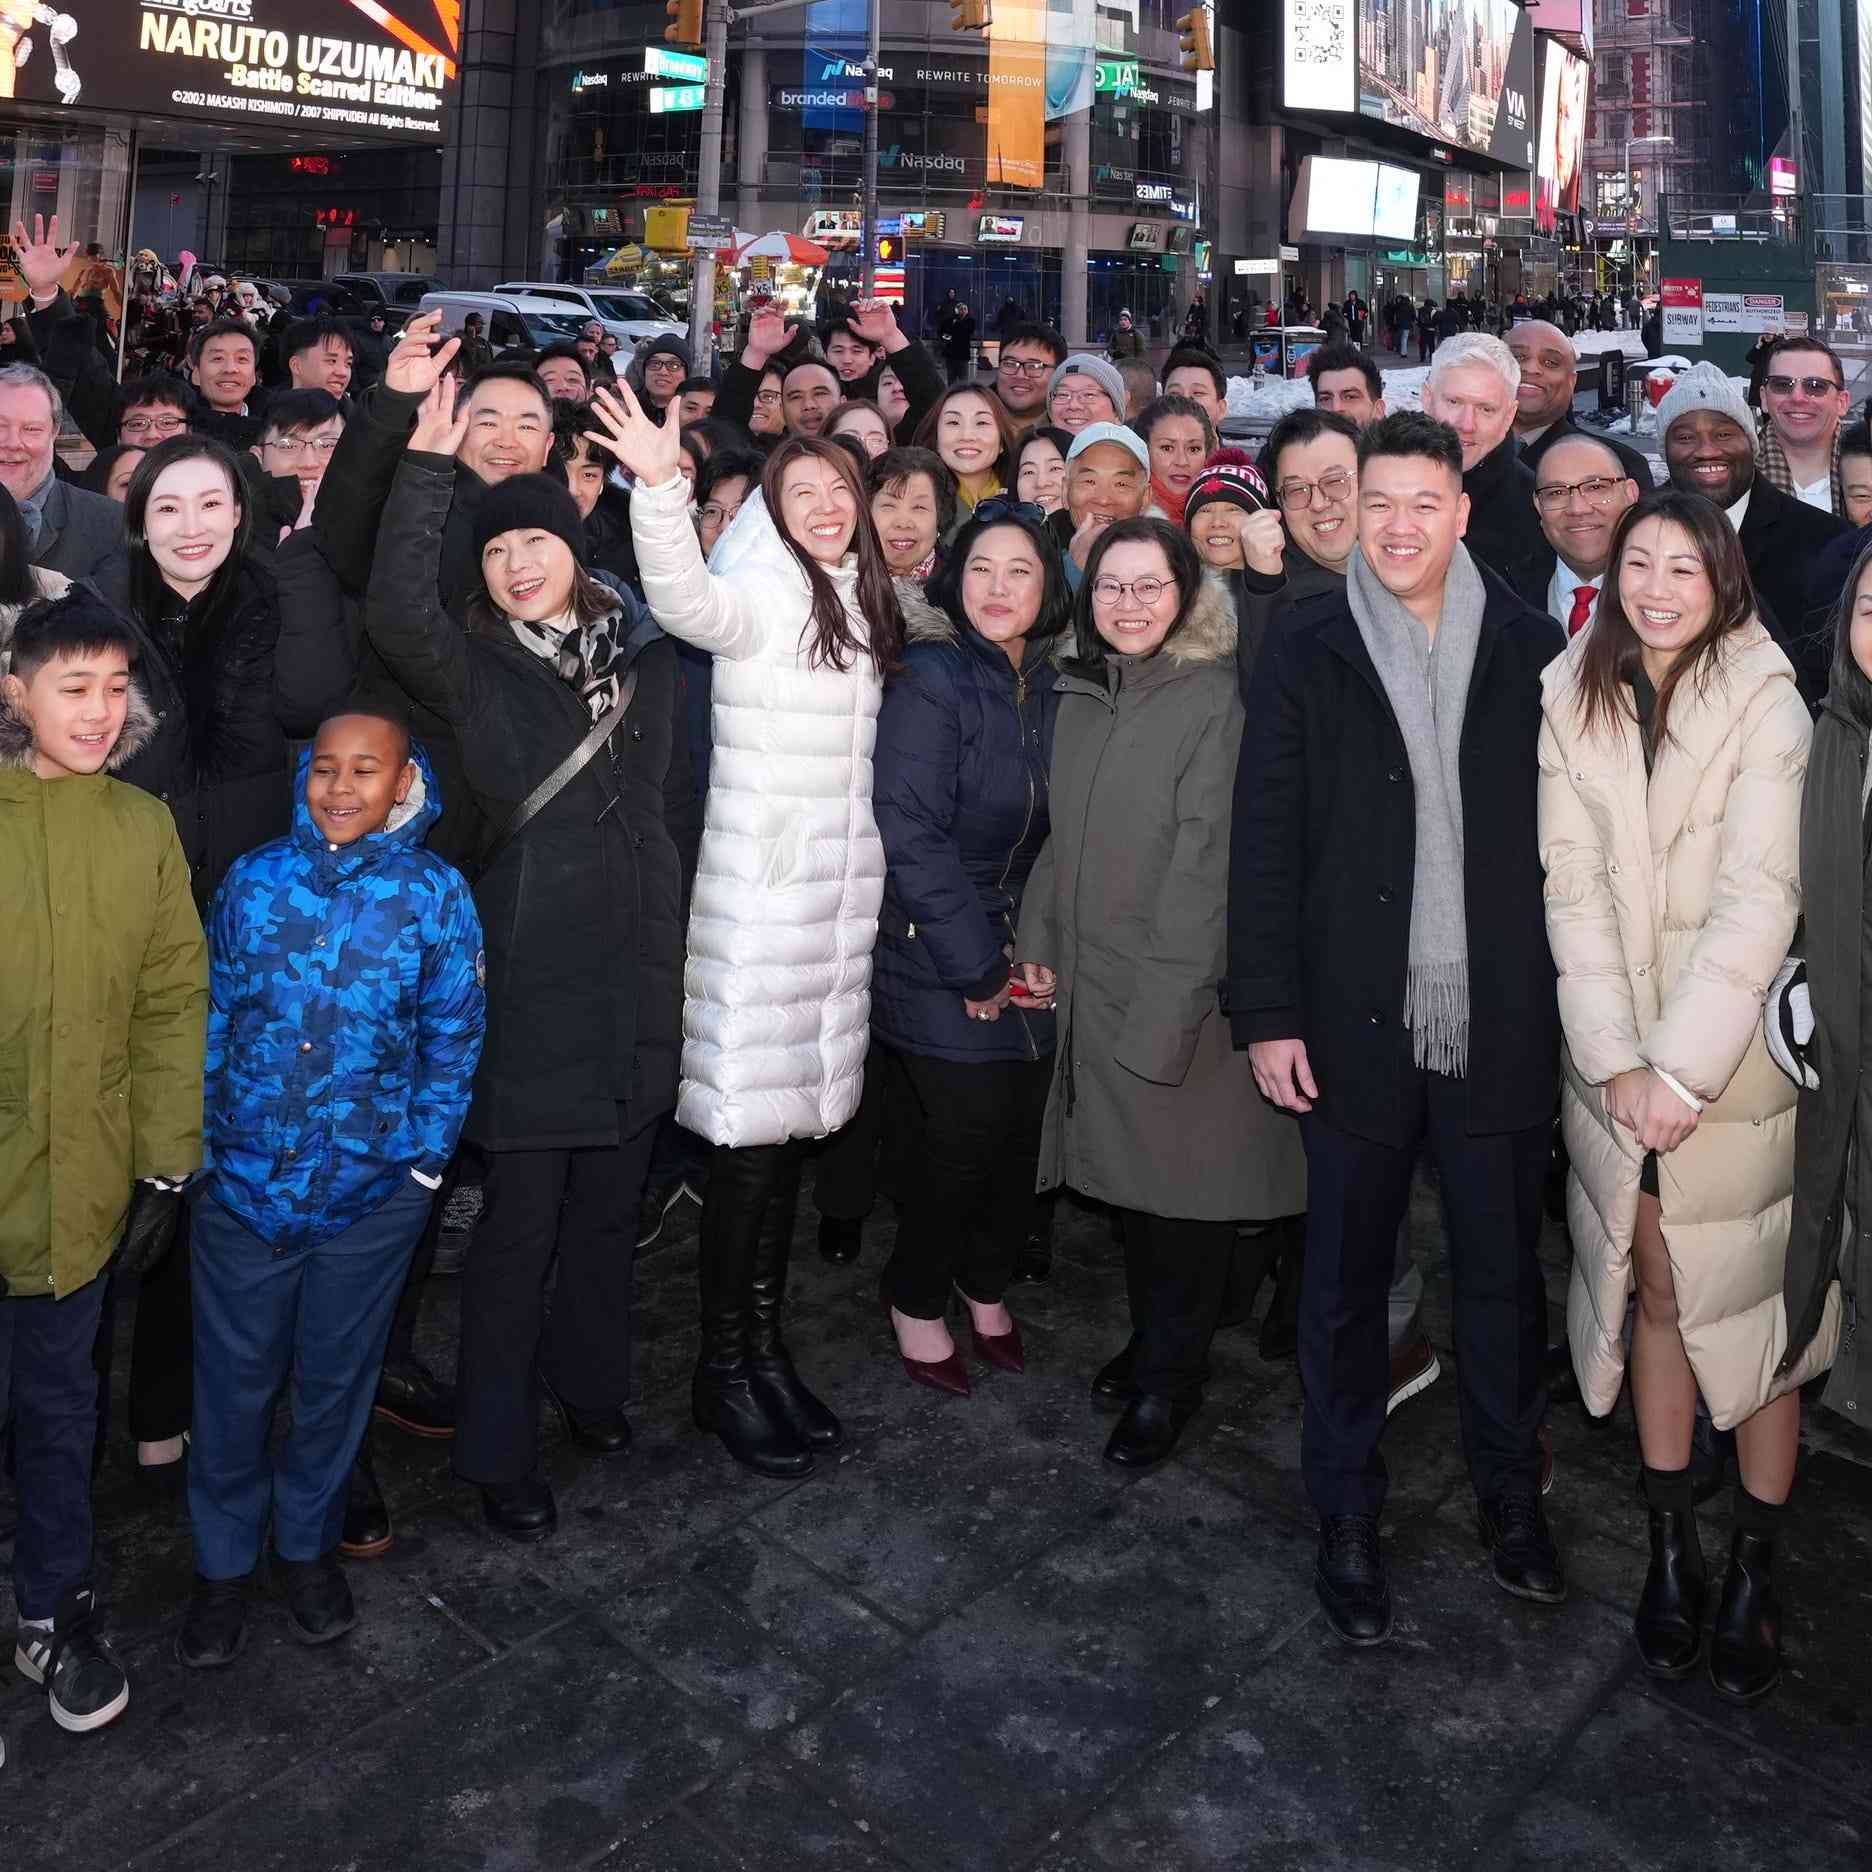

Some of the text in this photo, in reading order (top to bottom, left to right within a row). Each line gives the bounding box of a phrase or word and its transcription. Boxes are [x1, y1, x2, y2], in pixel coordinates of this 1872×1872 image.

[139, 11, 447, 90] NARUTO UZUMAKI
[296, 72, 371, 103] Scarred
[845, 63, 1042, 88] Naaq REWRITE TOMORROW
[780, 90, 848, 106] branded
[1505, 87, 1527, 120] VIA
[247, 98, 296, 117] KISHIMOTO
[301, 104, 323, 119] 2007
[322, 106, 368, 125] SHIPPUDEN
[899, 152, 966, 174] Nasdaq
[1705, 300, 1741, 313] PEDESTRIANS
[1666, 313, 1698, 326] SUBWAY
